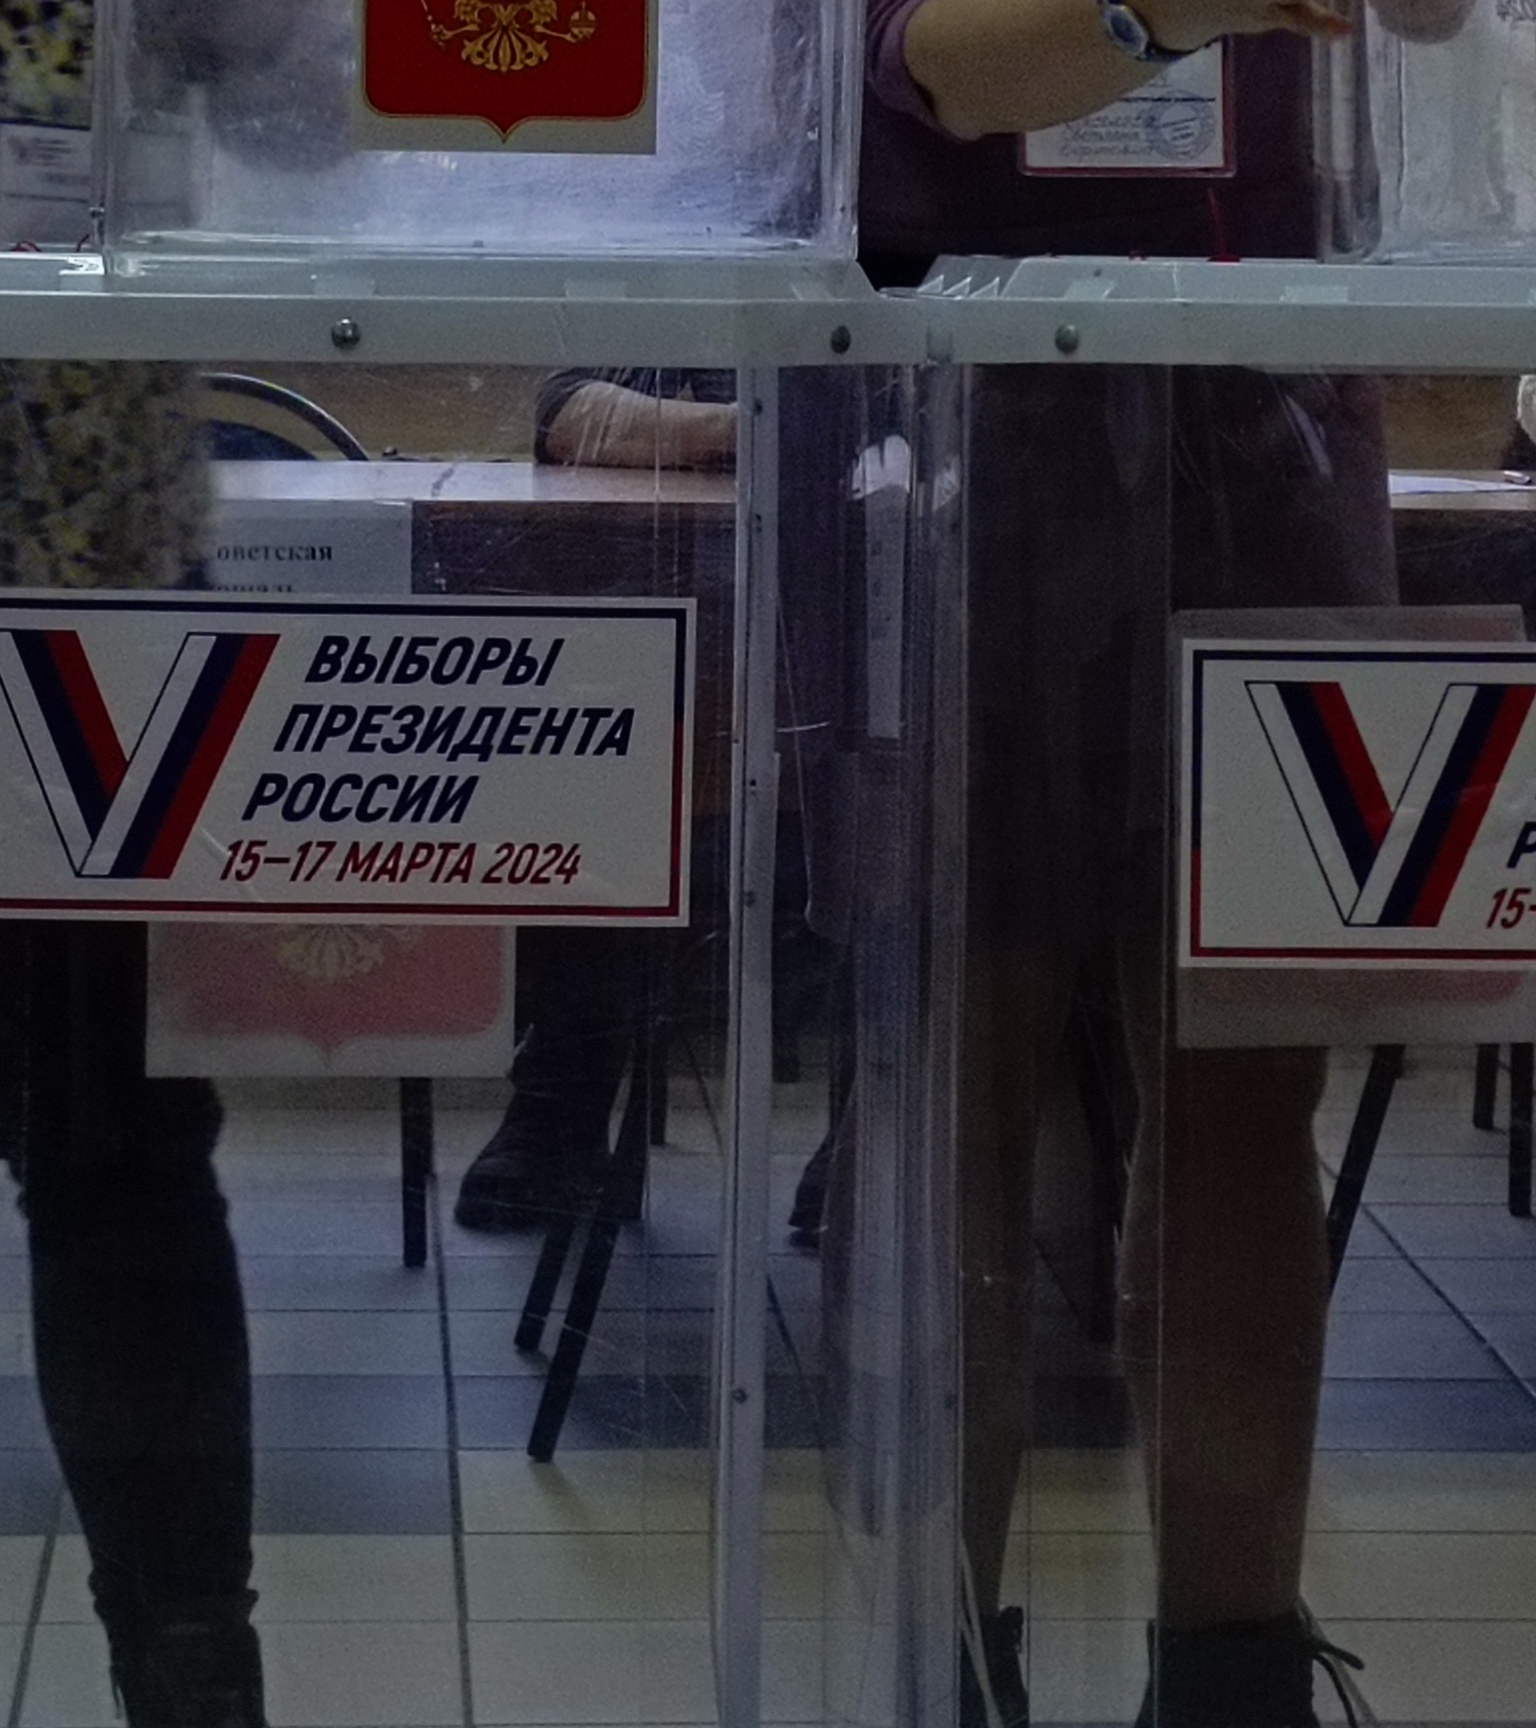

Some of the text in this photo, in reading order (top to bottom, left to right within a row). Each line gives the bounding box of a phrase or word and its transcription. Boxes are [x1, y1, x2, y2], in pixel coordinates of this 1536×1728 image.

[216, 545, 334, 562] оветская
[305, 635, 564, 686] ВЫБОРЫ
[273, 704, 635, 762] ПРЕЗИДЕНТА
[242, 773, 479, 824] РОССИИ
[336, 841, 476, 884] МАРТА
[482, 843, 581, 884] 2024
